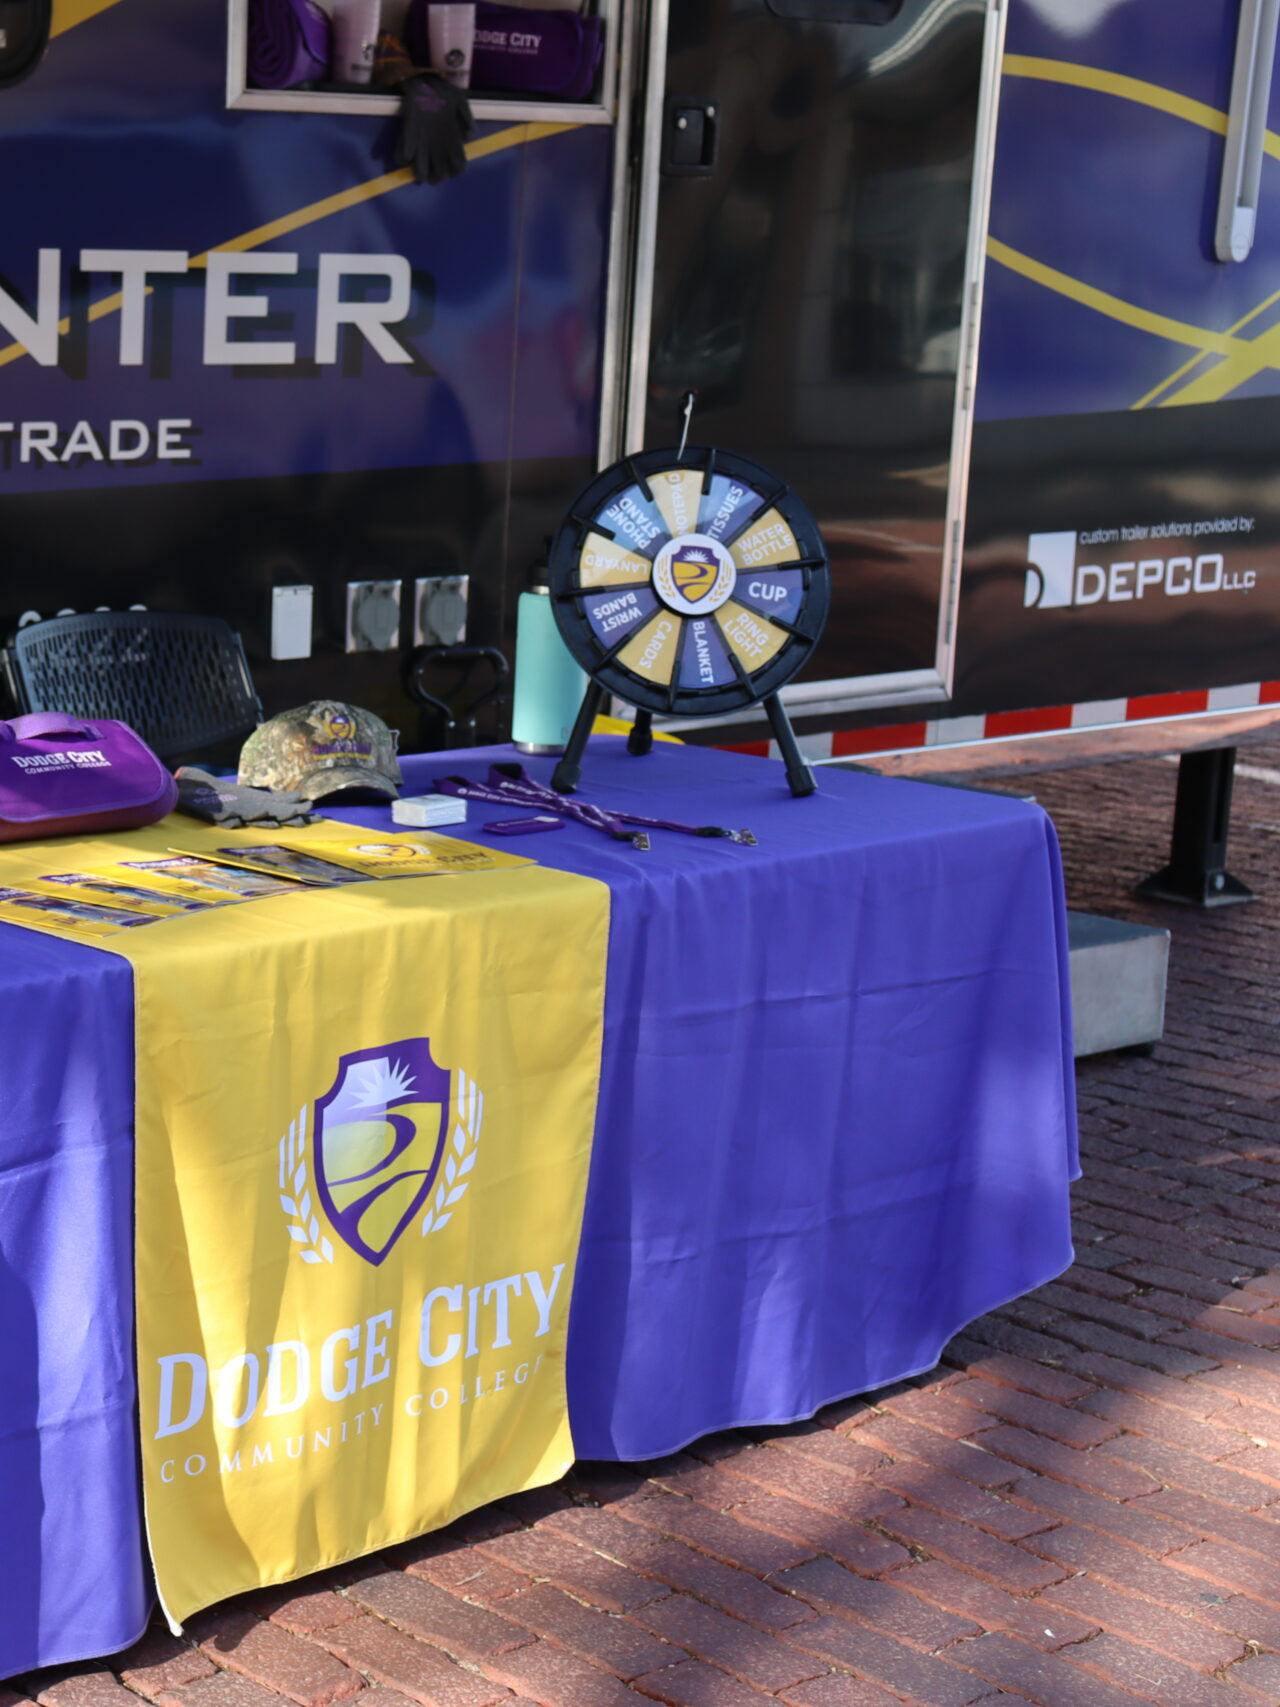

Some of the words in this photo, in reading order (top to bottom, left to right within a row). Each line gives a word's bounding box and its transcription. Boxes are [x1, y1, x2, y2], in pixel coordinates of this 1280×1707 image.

[510, 32, 542, 48] CITY
[606, 503, 651, 550] PHONE
[619, 497, 661, 540] STAND
[706, 485, 743, 541] TISSUES
[738, 523, 786, 552] WATER
[1079, 526, 1119, 545] custom
[1121, 523, 1149, 541] trailer
[1150, 521, 1192, 540] solutions
[1193, 517, 1238, 538] provided
[1238, 516, 1256, 533] by:
[584, 552, 648, 574] LANYARD
[741, 532, 794, 566] BOTTLE
[747, 581, 788, 603] CUP
[1074, 553, 1224, 606] DEPCO
[1222, 570, 1257, 590] LLC
[593, 592, 637, 620] BANDS
[602, 606, 642, 633] WRIST
[639, 620, 672, 669] CARDS
[723, 619, 762, 658] LIGHT
[736, 612, 769, 646] RING
[692, 621, 714, 684] BLANKET
[10, 752, 70, 769] DODGE
[67, 750, 107, 764] CITY
[24, 762, 75, 775] COMMUNITY
[76, 760, 112, 770] COLLEGE
[154, 1309, 393, 1439] DODGE
[419, 1263, 566, 1368] CITY
[160, 1402, 385, 1484] COMMUNITY
